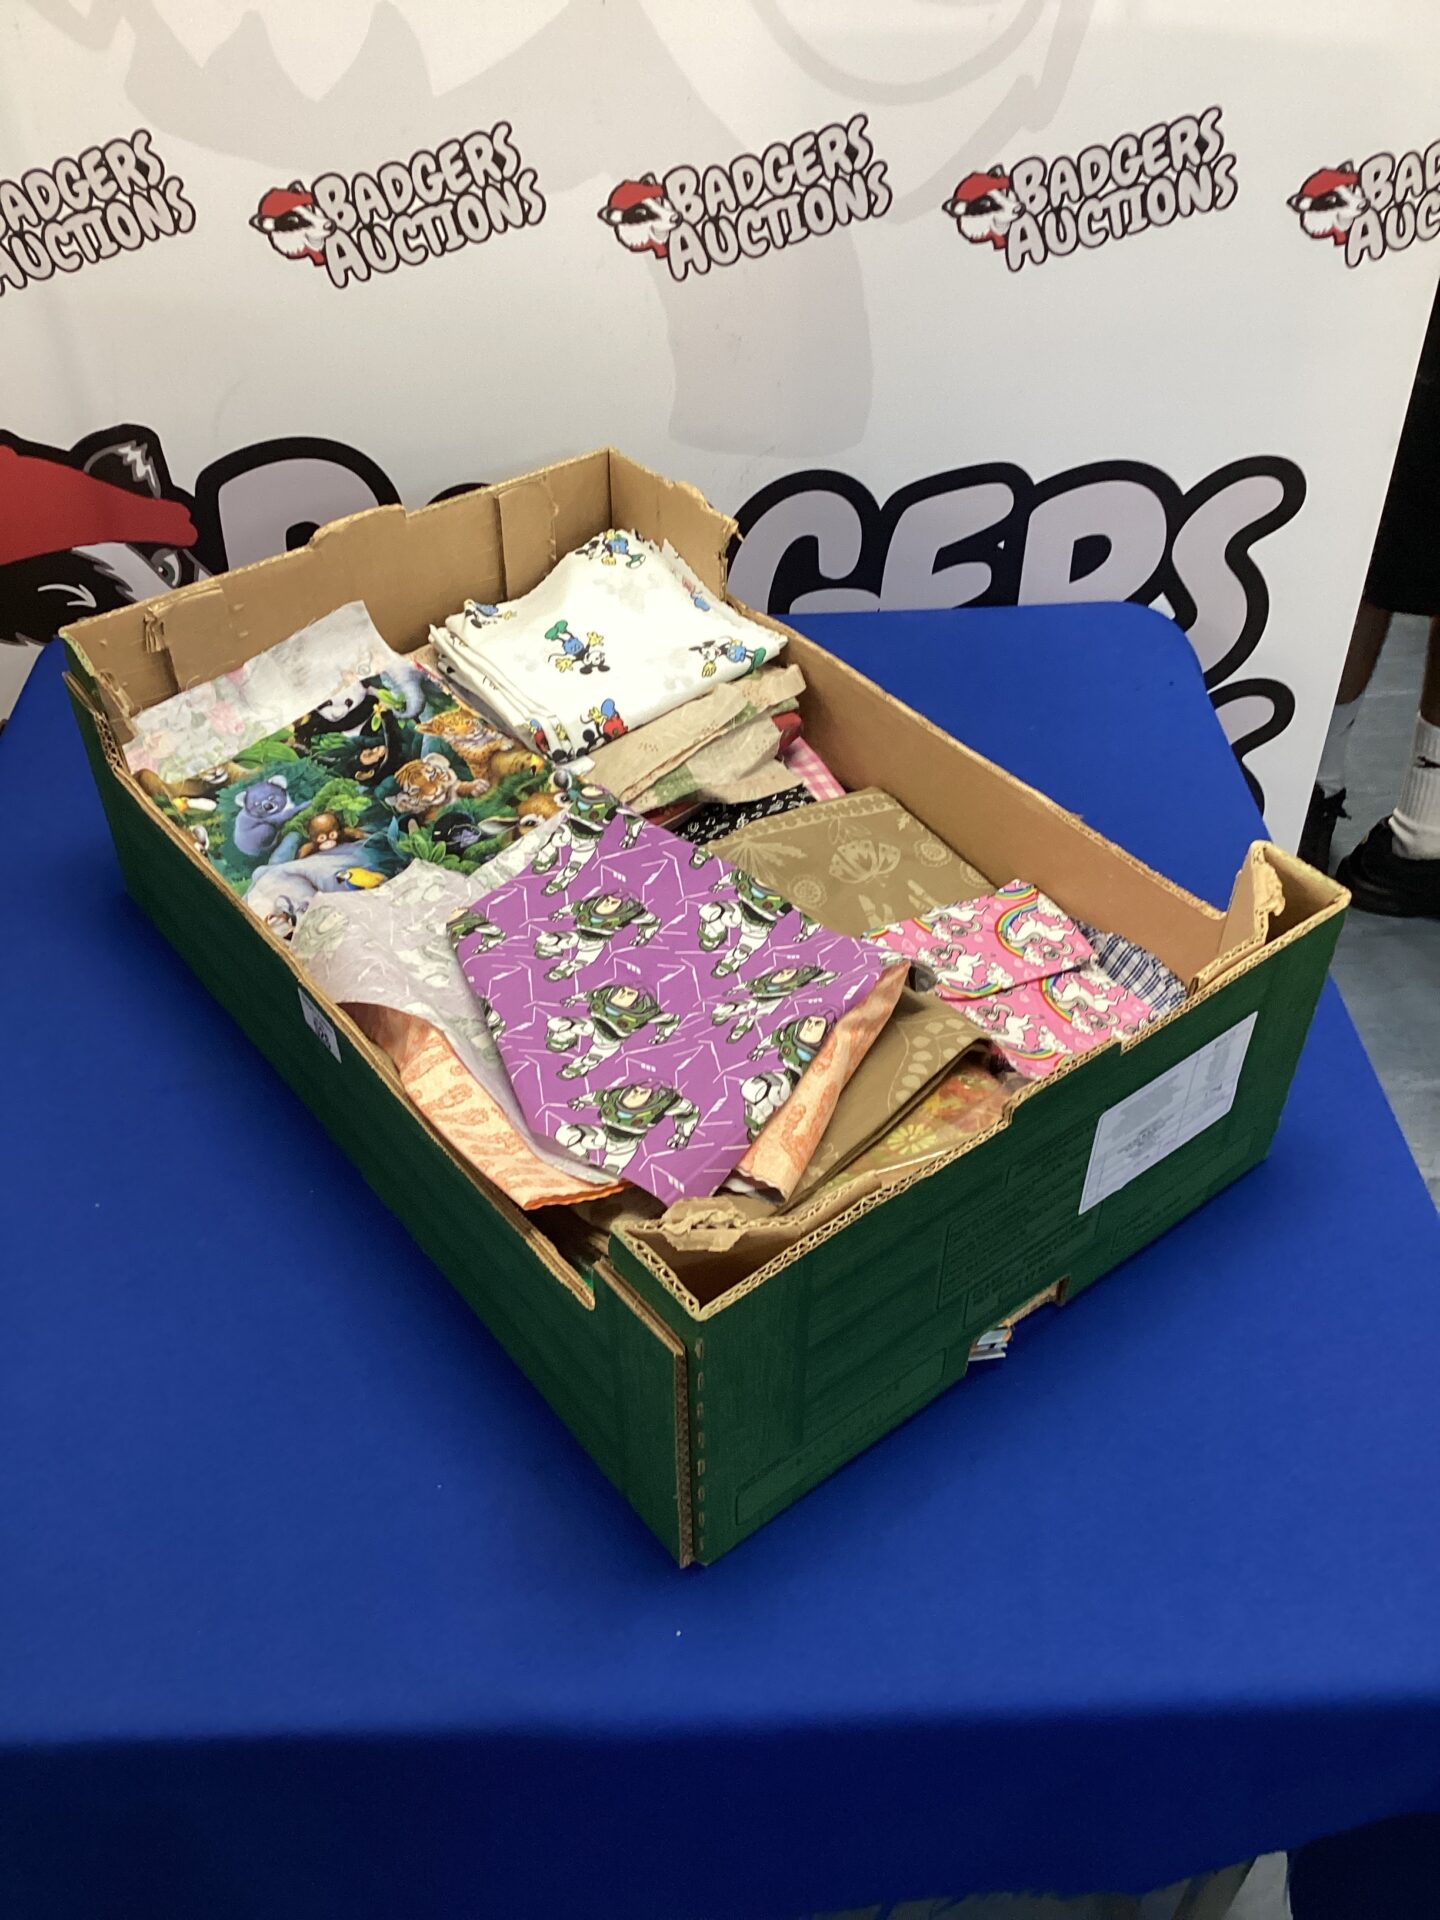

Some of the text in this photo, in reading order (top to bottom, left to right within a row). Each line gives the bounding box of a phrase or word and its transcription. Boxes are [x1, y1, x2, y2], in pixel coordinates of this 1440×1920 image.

[0, 128, 165, 241] ADGERS
[311, 120, 521, 233] BADGERS
[663, 112, 873, 225] BADGERS
[1005, 153, 1238, 272] AUCTIONS
[1010, 106, 1224, 217] BADGERS
[325, 168, 546, 289] AUCTIONS
[668, 160, 892, 282] AUCTIONS
